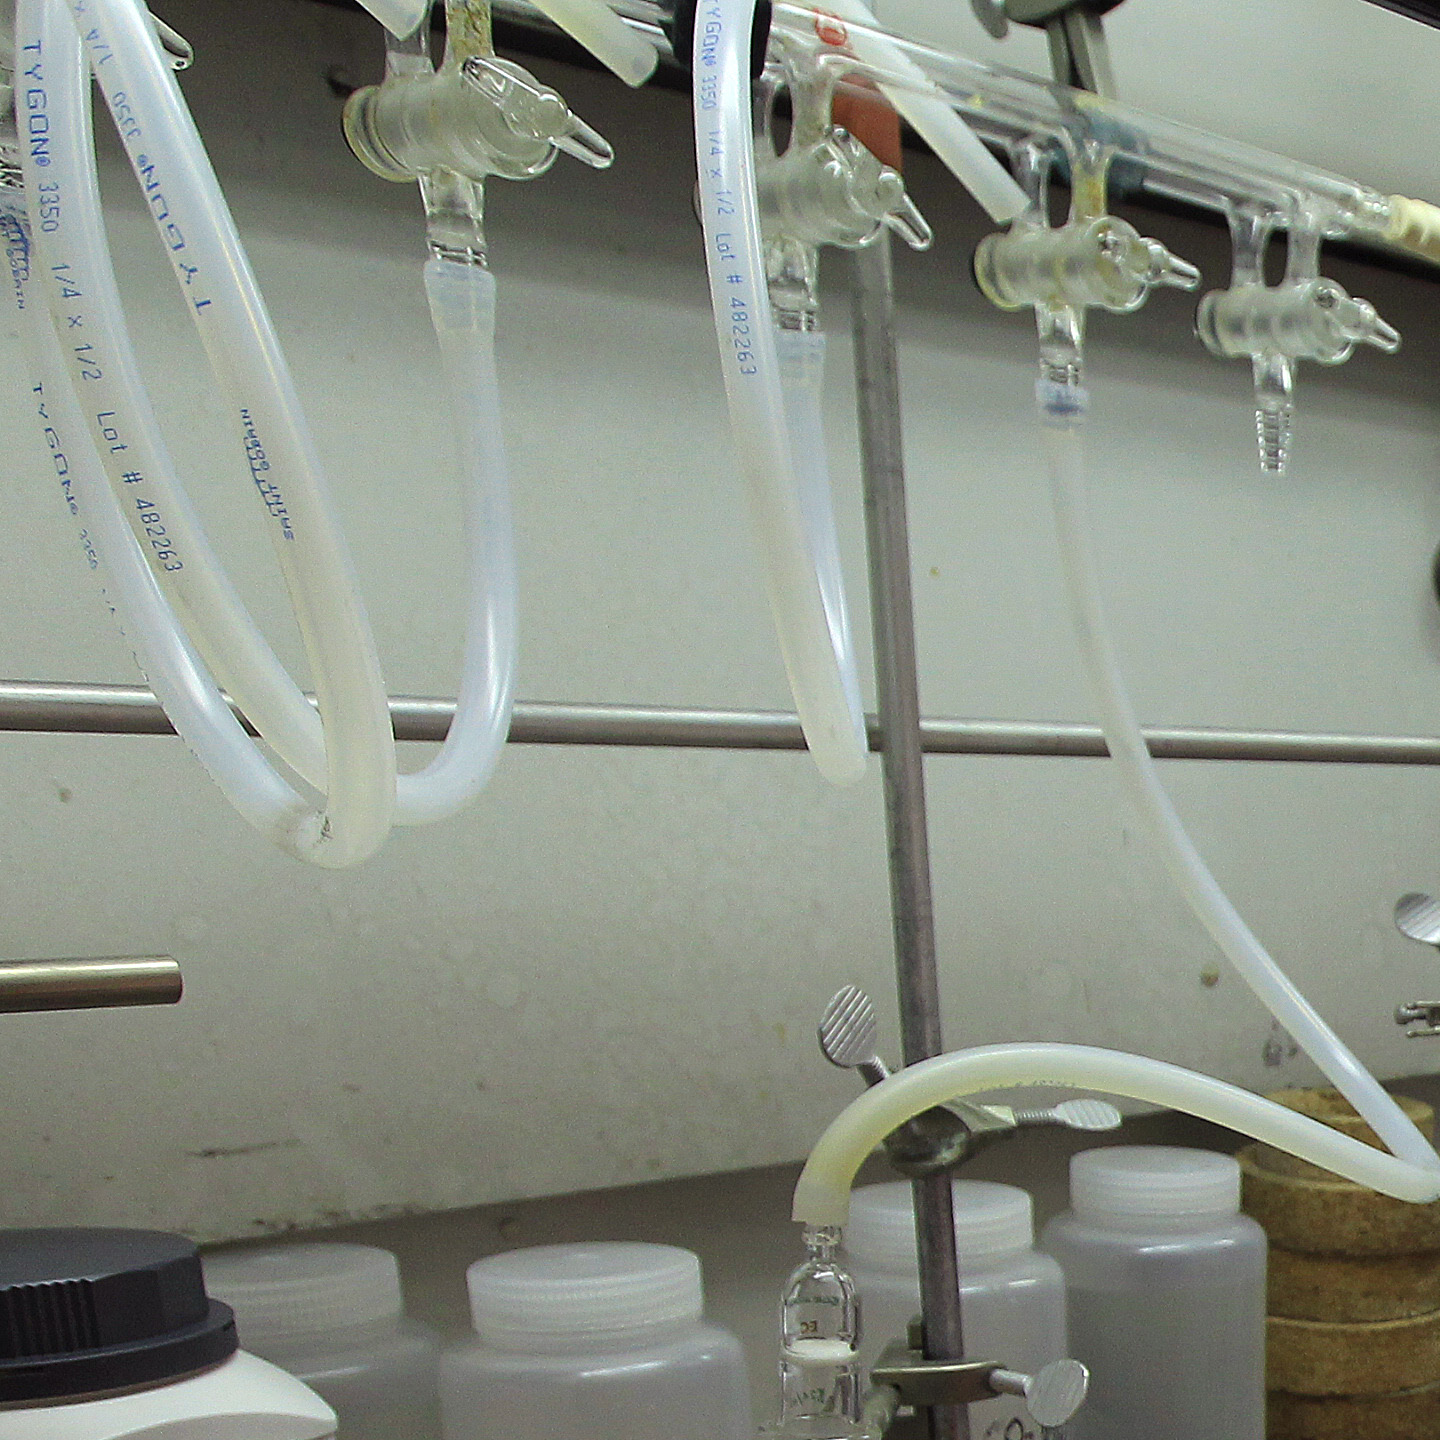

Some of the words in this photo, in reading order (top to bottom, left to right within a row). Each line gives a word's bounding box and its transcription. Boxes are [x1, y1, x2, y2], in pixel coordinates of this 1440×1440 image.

[726, 273, 744, 286] #
[730, 296, 757, 377] 482263
[39, 182, 60, 234] 3350
[51, 262, 82, 300] 1/4
[75, 343, 103, 381] 1/2
[97, 411, 129, 454] Lot
[121, 471, 144, 485] #
[136, 498, 184, 573] 482263
